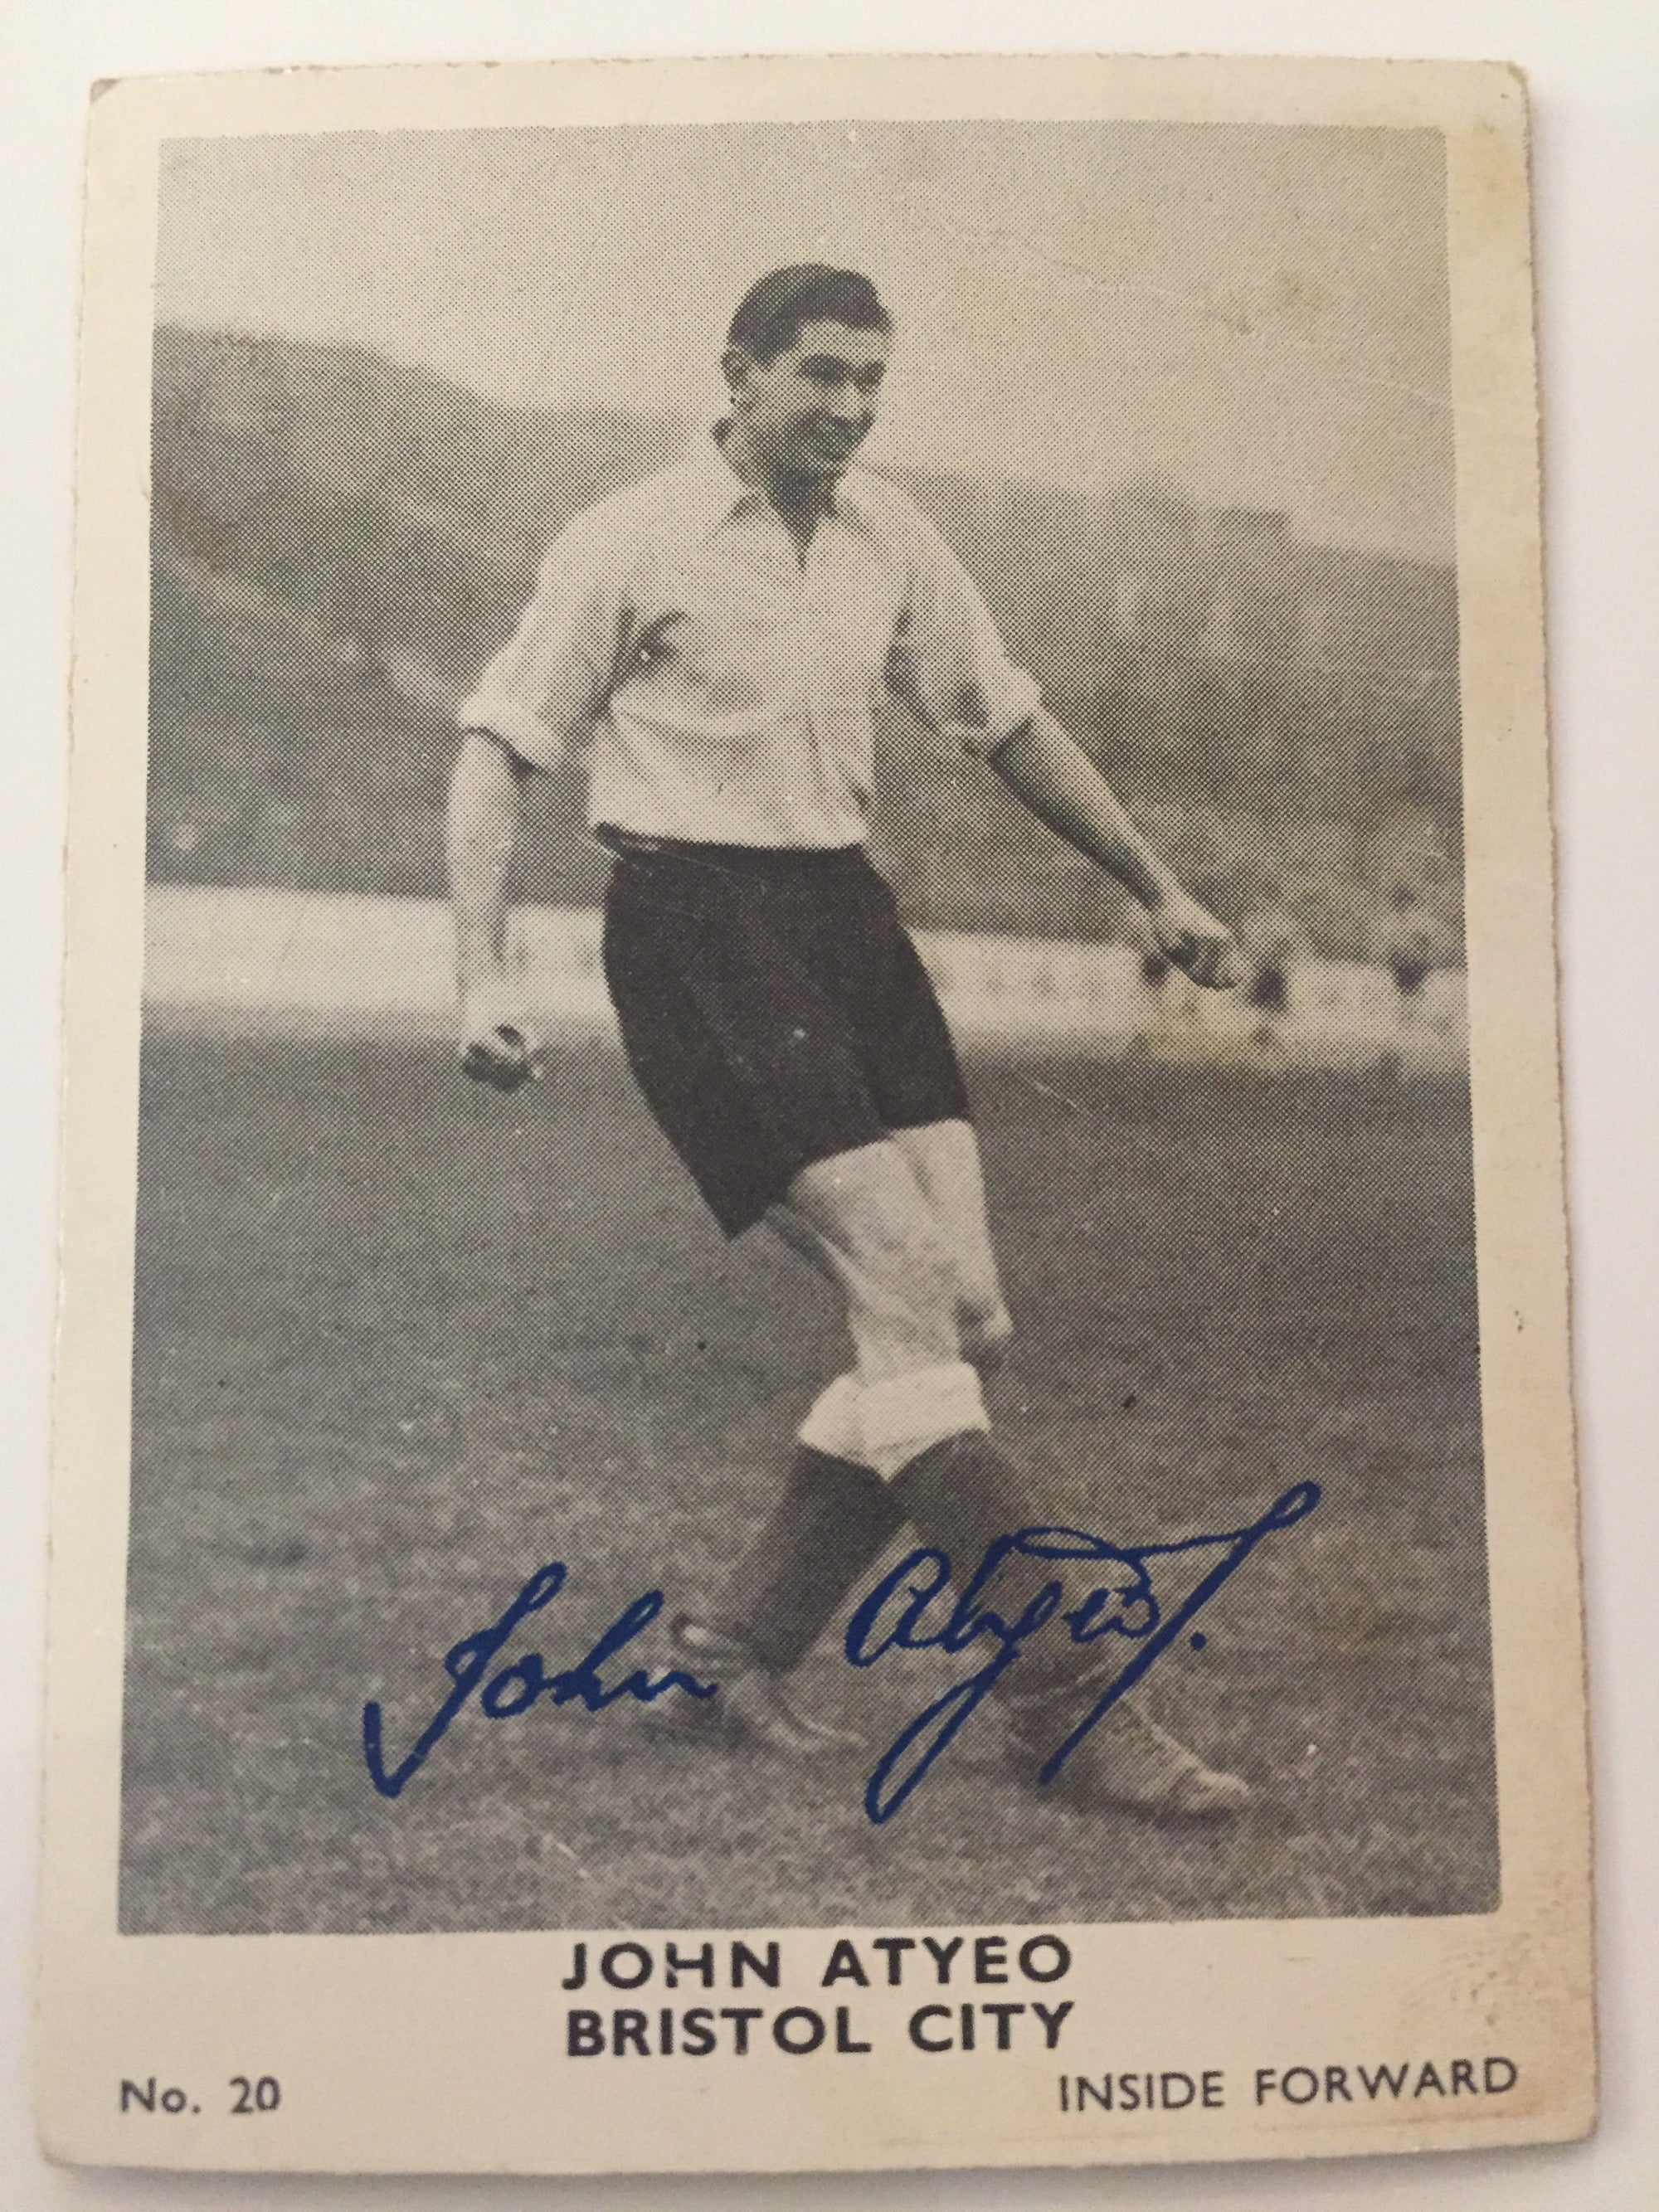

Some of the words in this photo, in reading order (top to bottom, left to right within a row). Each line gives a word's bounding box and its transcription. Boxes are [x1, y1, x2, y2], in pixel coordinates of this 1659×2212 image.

[363, 1563, 717, 1798] John
[562, 1942, 780, 1991] JOHN
[820, 1935, 1073, 1989] ATYEO
[567, 2005, 873, 2059] BRISTOL
[907, 2000, 1075, 2054] CITY
[120, 2077, 200, 2114] No.
[229, 2076, 281, 2115] 20
[1059, 2069, 1225, 2112] INSIDE
[1254, 2056, 1519, 2107] FORWARD
